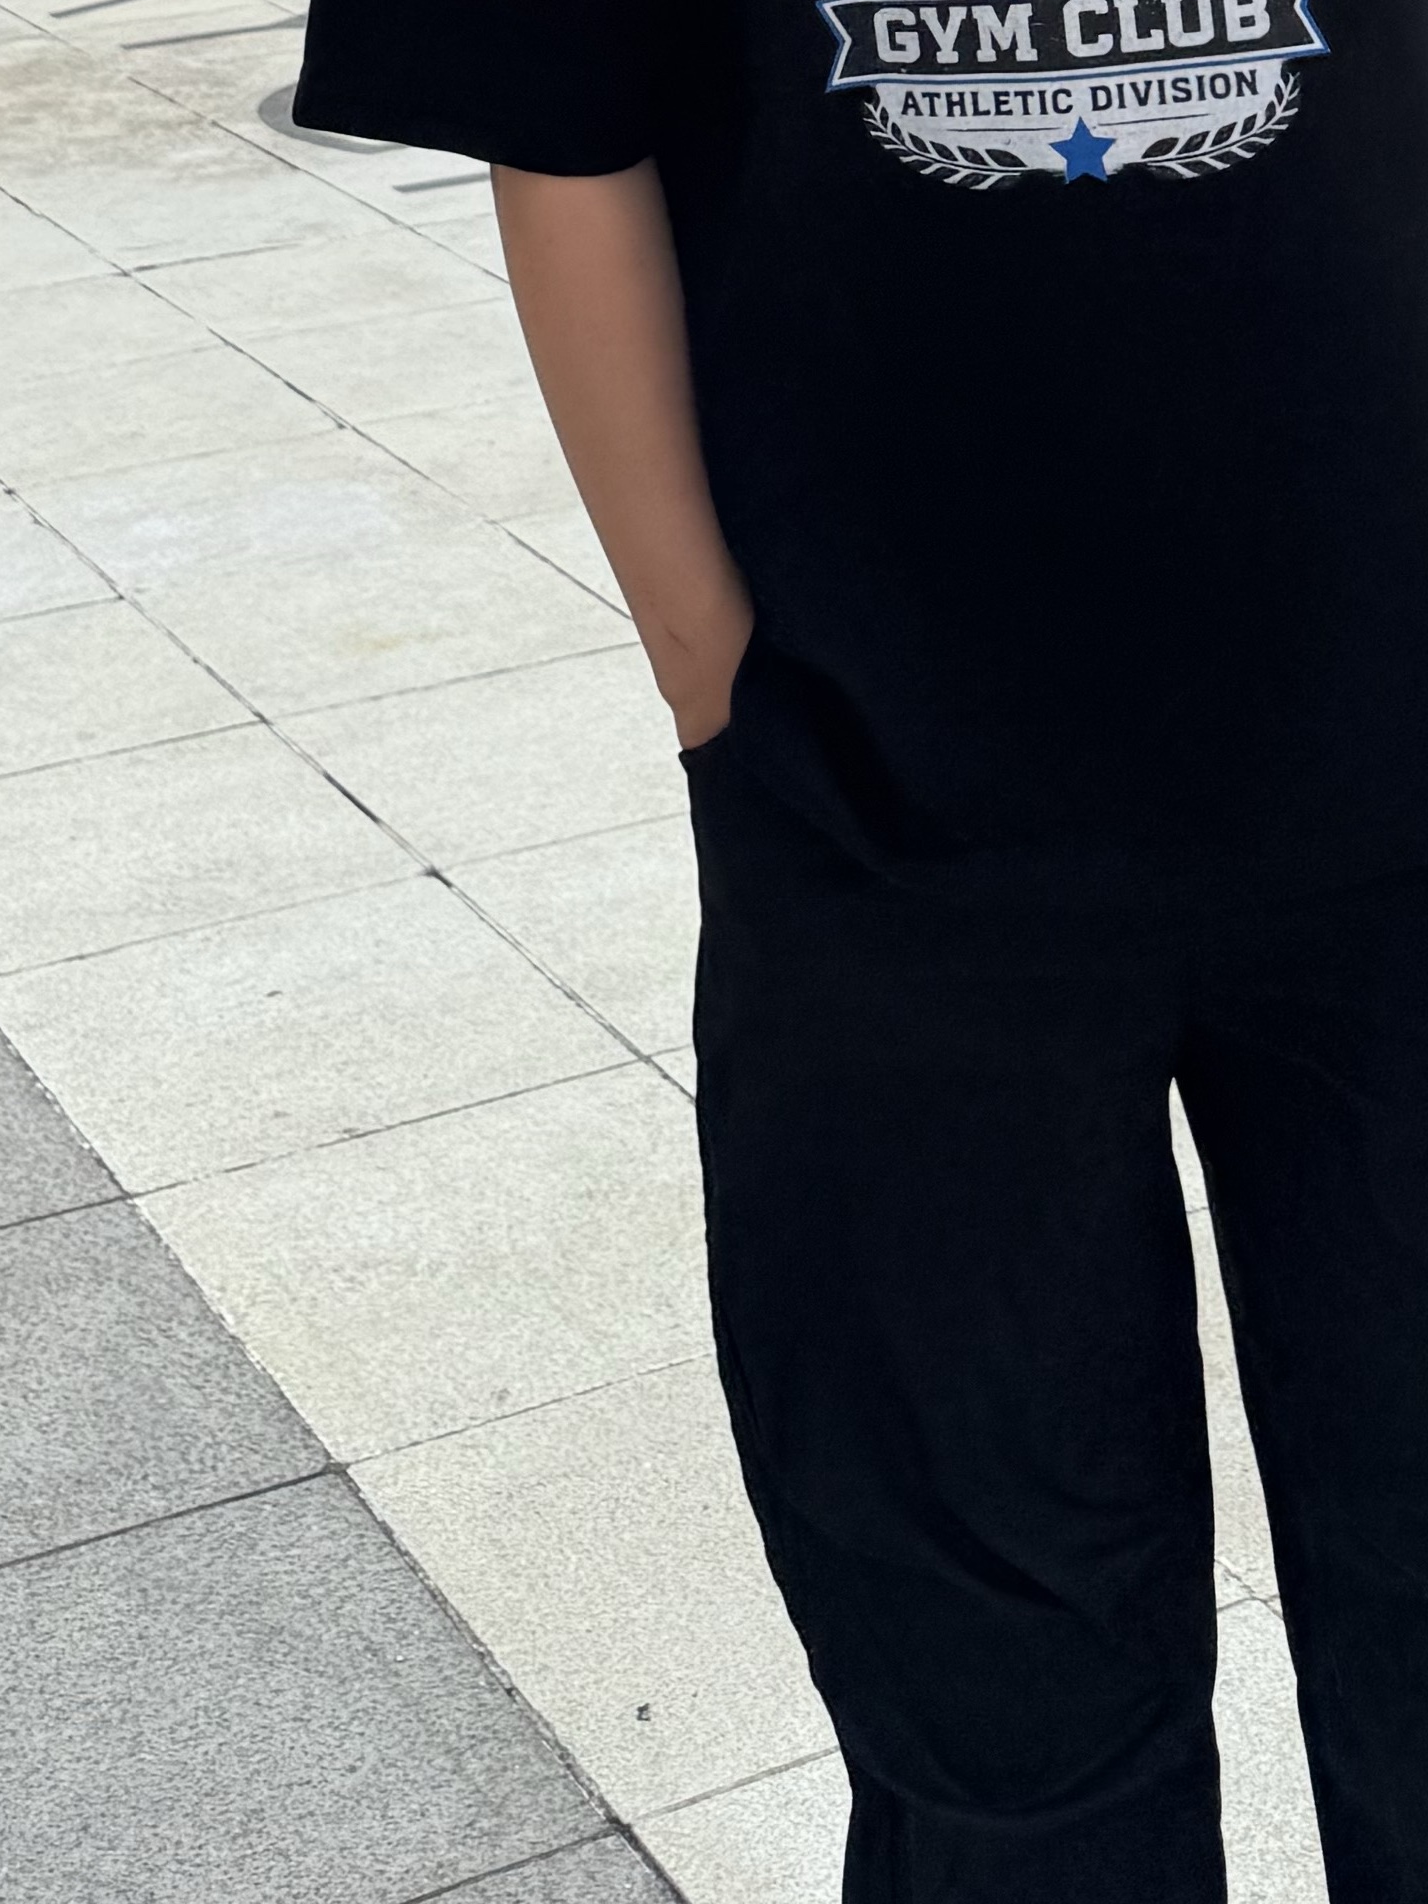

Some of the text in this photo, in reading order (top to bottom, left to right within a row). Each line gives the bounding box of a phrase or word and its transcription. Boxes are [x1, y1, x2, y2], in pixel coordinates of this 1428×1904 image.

[872, 0, 1038, 65] GYM
[900, 69, 1259, 117] ATHLETIC DIVISION
